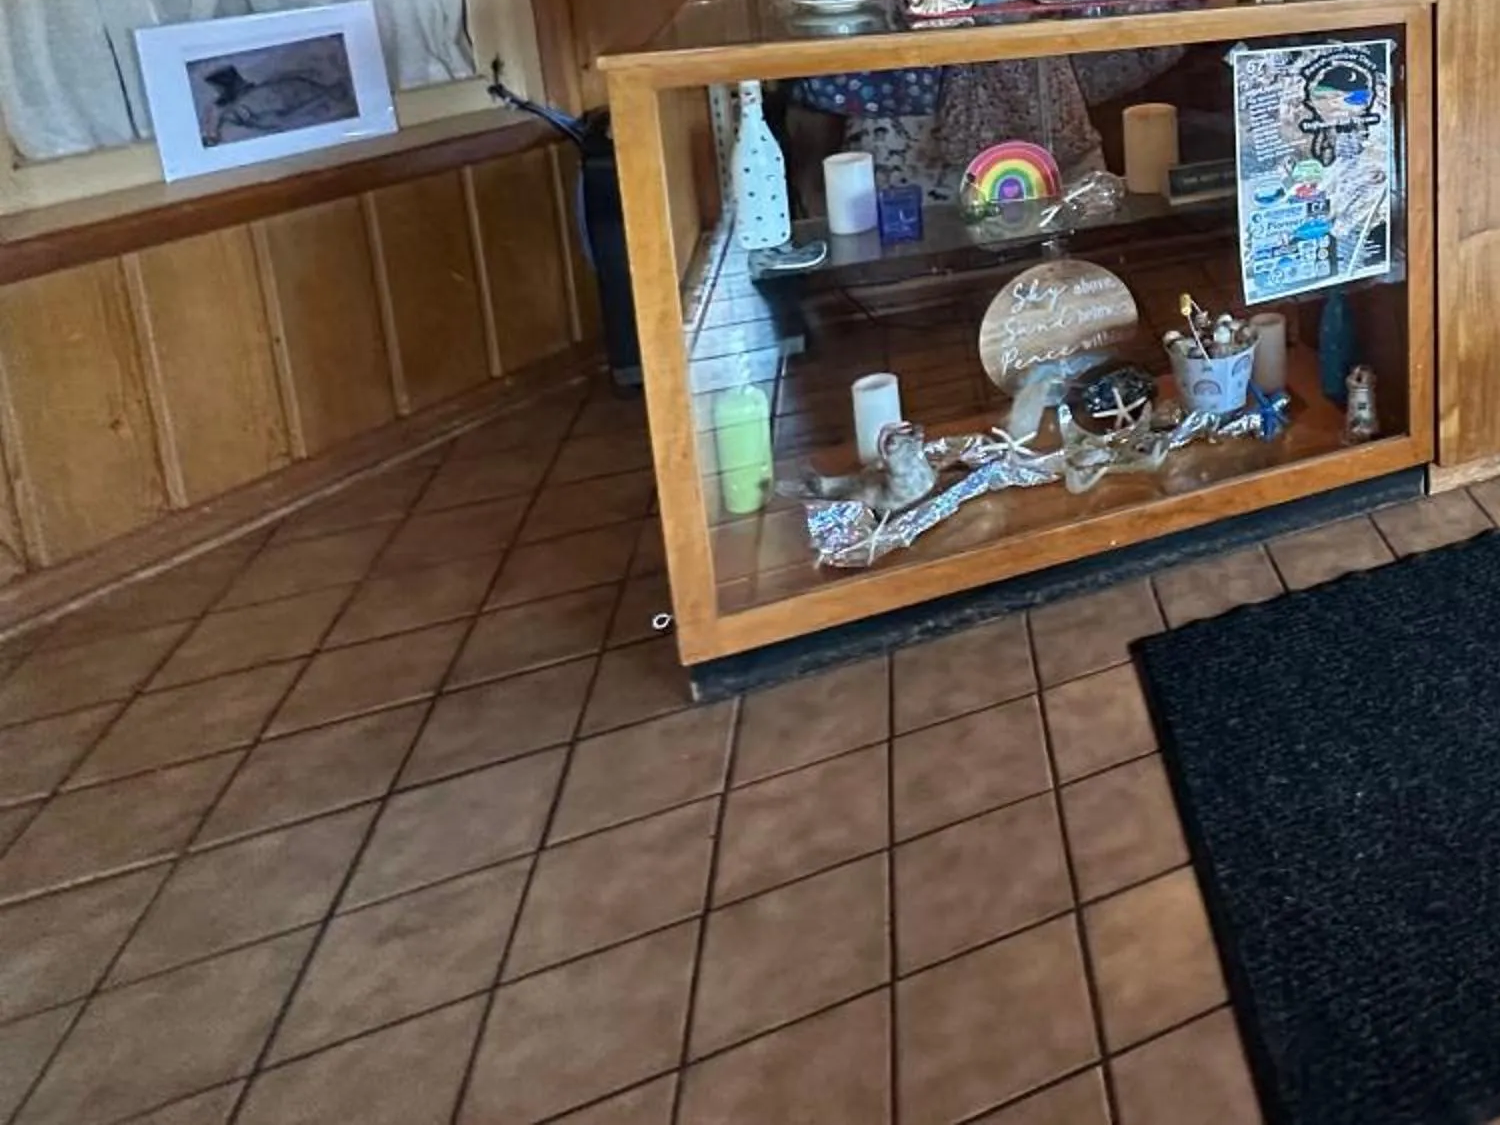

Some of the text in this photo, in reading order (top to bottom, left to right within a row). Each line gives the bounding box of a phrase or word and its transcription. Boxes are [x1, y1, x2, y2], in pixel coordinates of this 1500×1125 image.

[1012, 278, 1068, 314] Sky
[1002, 307, 1071, 348] Sand
[1001, 346, 1080, 377] Peace
